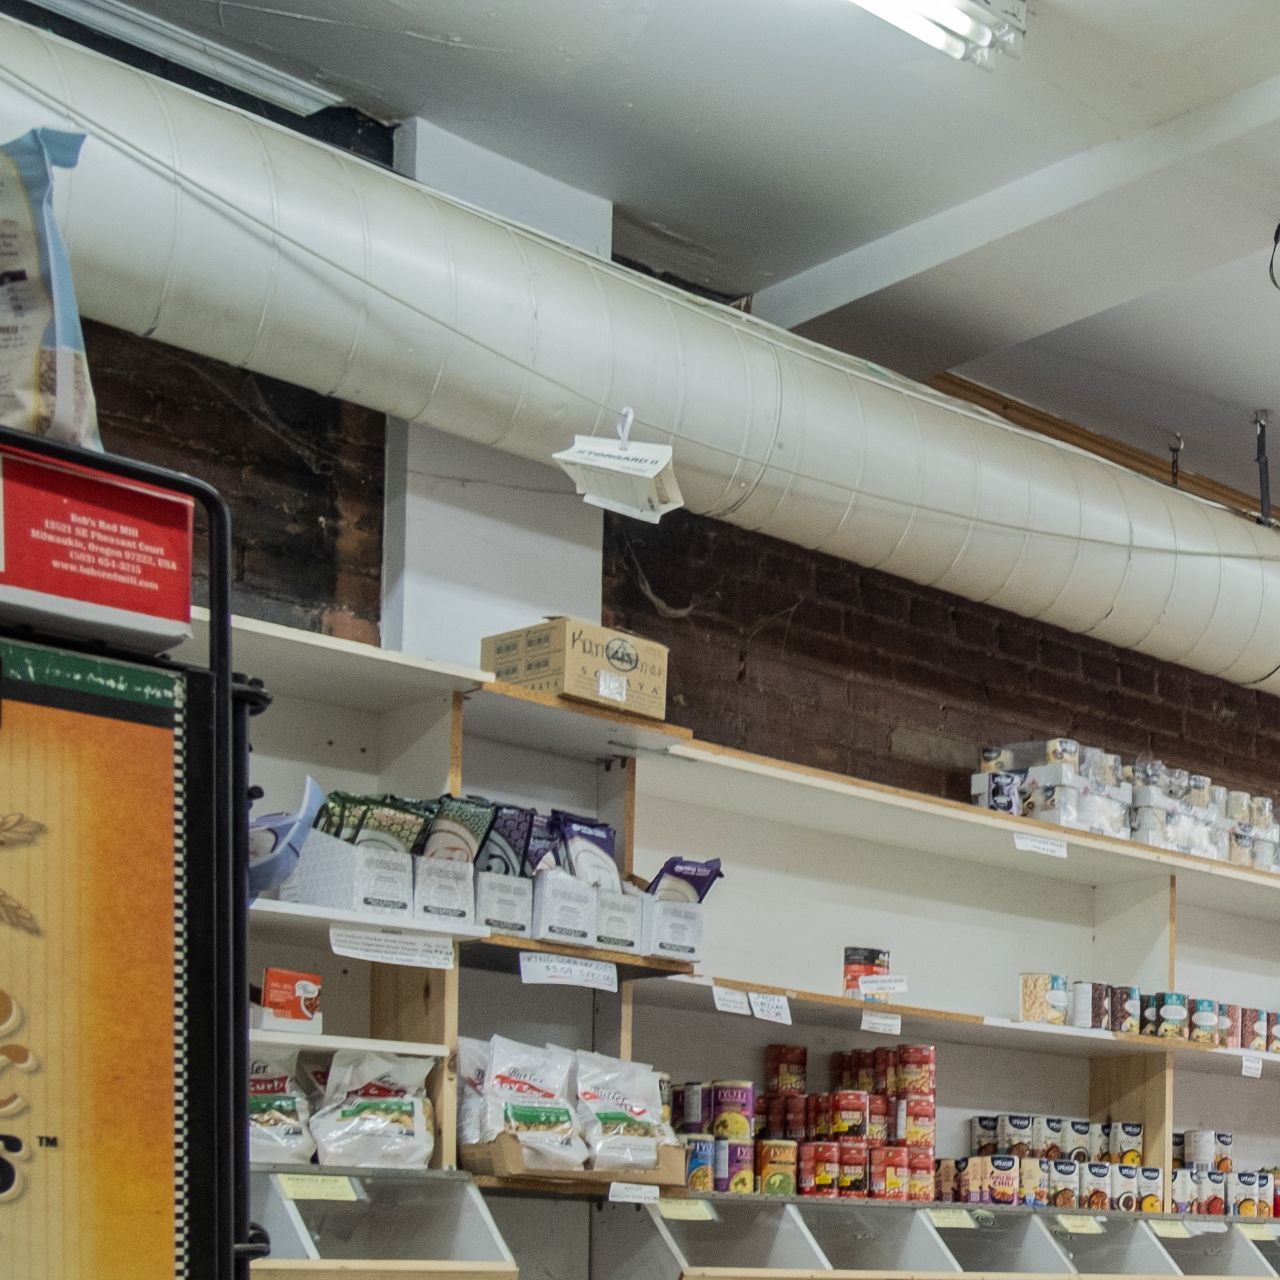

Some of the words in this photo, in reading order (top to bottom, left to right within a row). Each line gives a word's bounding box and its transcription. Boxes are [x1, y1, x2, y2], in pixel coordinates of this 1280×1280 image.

[98, 520, 118, 531] Red
[119, 524, 139, 538] Mill
[37, 1136, 58, 1148] TM
